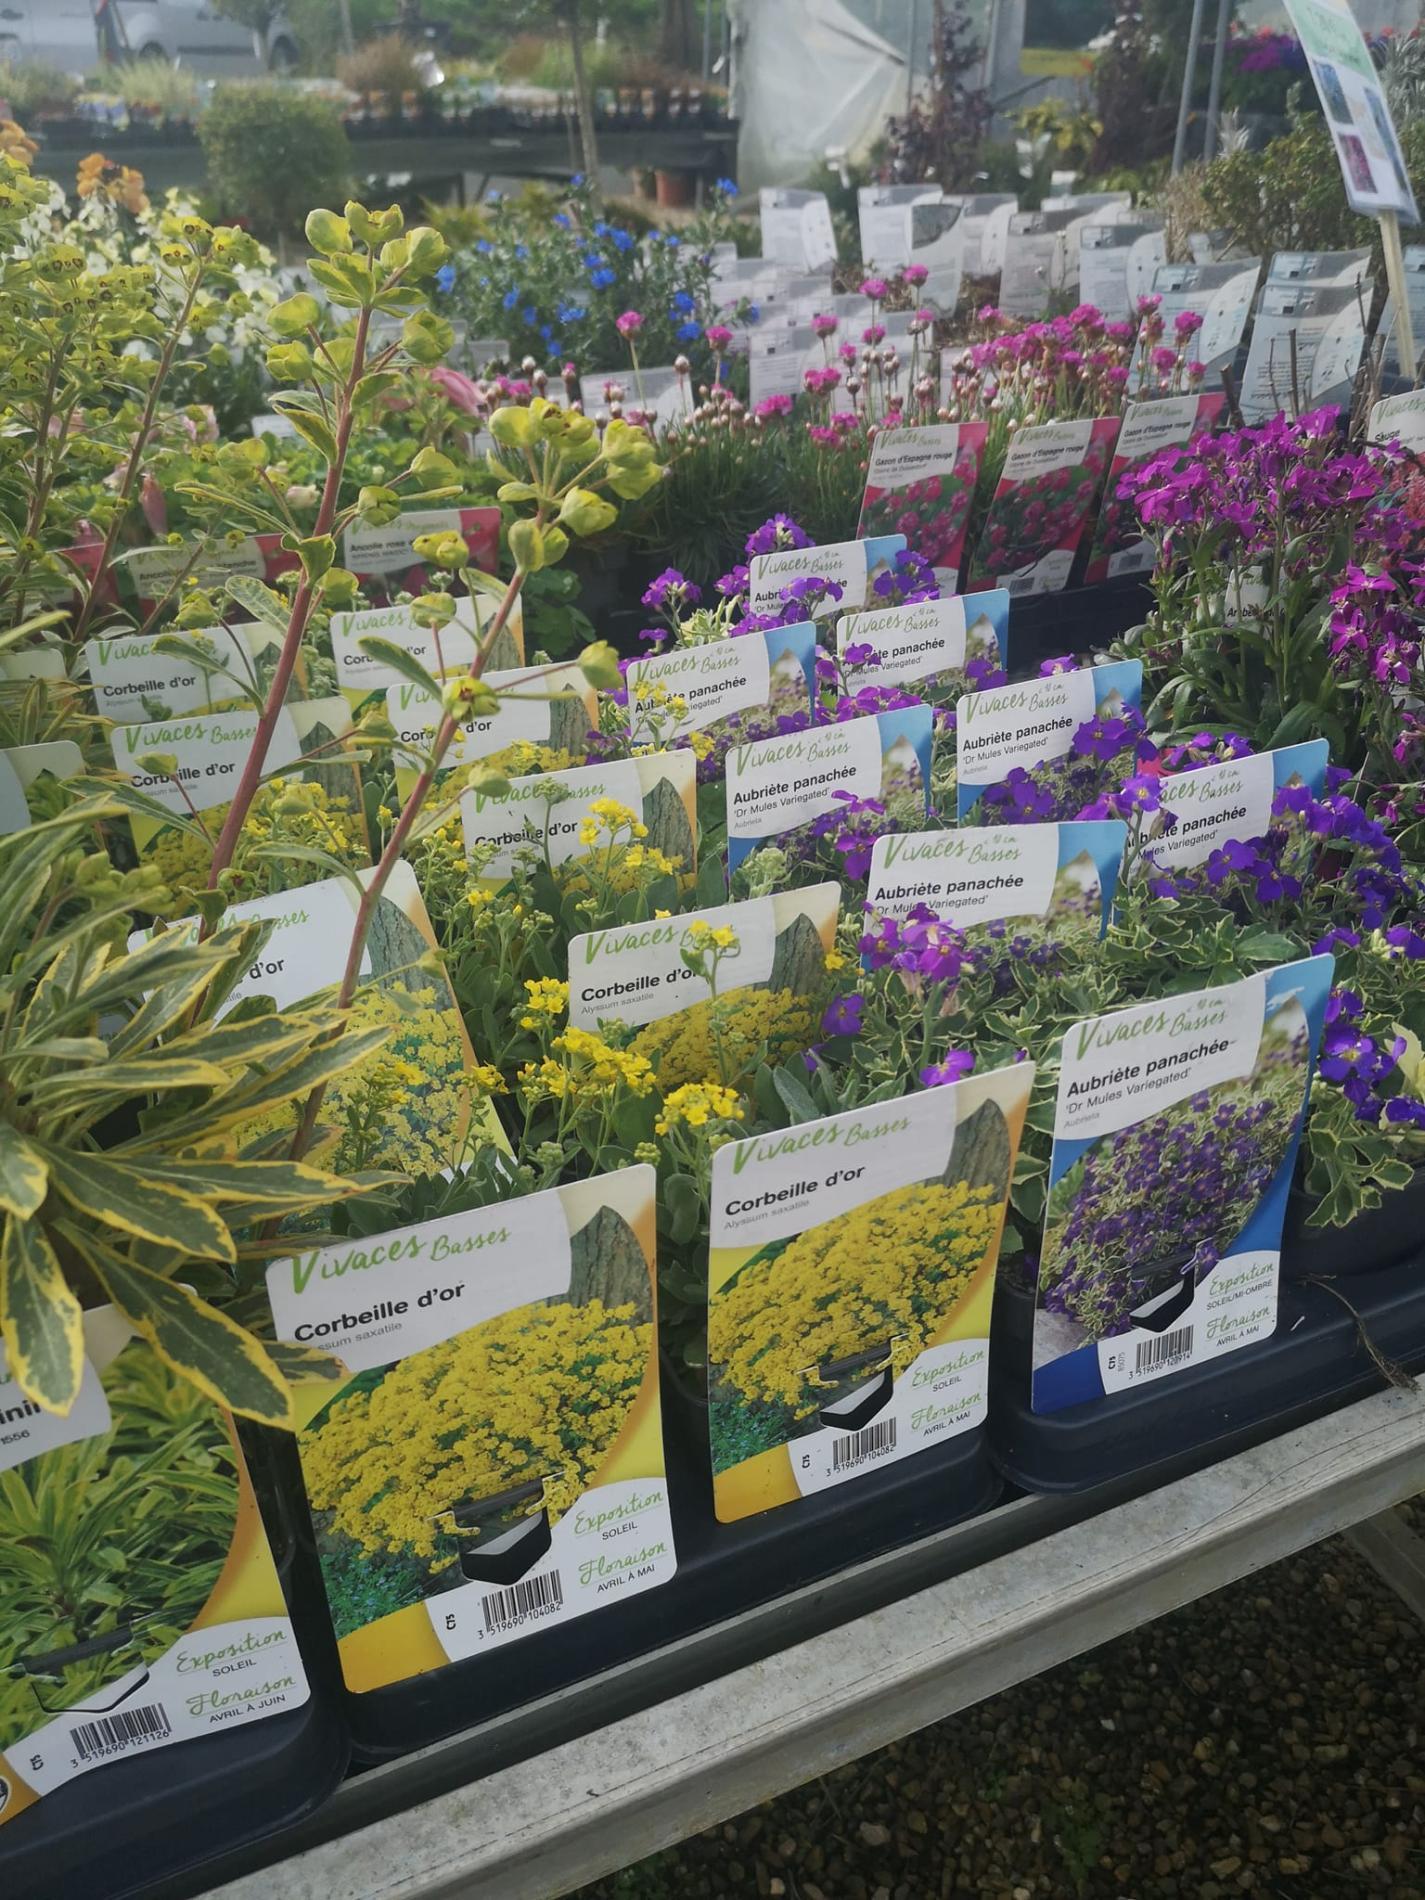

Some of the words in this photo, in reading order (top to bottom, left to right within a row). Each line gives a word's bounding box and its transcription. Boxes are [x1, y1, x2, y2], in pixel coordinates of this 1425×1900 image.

[758, 556, 809, 580] Vivaces
[845, 614, 902, 642] Vivaces
[903, 616, 940, 633] Basses
[892, 638, 945, 659] panachée
[637, 655, 697, 683] Vivaces
[700, 655, 741, 674] Basses
[103, 679, 166, 697] Corbeille
[169, 676, 196, 689] d'or
[689, 676, 747, 701] panachée
[966, 691, 1026, 724] Vivaces
[1028, 692, 1068, 712] Basses
[126, 722, 207, 753] Vivaces
[465, 721, 493, 734] d'or
[962, 731, 1012, 752] Aubriète
[1016, 716, 1073, 740] panachée
[205, 763, 236, 777] d'or
[736, 743, 805, 776] Vivaces
[807, 742, 850, 763] Basses
[977, 749, 1002, 761] Mules
[733, 783, 789, 805] Aubriète
[793, 765, 857, 790] panachée
[1198, 780, 1244, 802] Basses
[750, 800, 778, 814] Mules
[1182, 805, 1247, 835] panachée
[548, 822, 579, 837] d'or
[883, 836, 967, 870] Vivaces
[875, 882, 941, 901] Aubriète
[946, 874, 1024, 895] panachée
[584, 925, 678, 965] Vivaces
[249, 958, 285, 981] d'or
[580, 975, 660, 1002] Corbeille
[1076, 1011, 1167, 1061] Vivaces
[1168, 1010, 1226, 1038] Basses
[1067, 1066, 1141, 1098] Aubriète
[1145, 1039, 1229, 1076] panachée
[1086, 1090, 1123, 1108] Mules
[733, 1122, 843, 1175] Vivaces
[843, 1116, 912, 1148] Basses
[725, 1180, 818, 1216] Corbeille
[825, 1165, 867, 1188] d'or
[724, 1212, 769, 1230] Alyssum
[291, 1235, 426, 1294] Vivaces
[429, 1227, 512, 1261] Basses
[1208, 1261, 1274, 1296] Exposition
[294, 1300, 409, 1342] Corbeille
[417, 1284, 466, 1308] d'or
[1206, 1305, 1271, 1340] Floraison
[355, 1322, 403, 1341] saxatile
[1216, 1334, 1238, 1347] AVRIL
[1246, 1325, 1260, 1336] MAI
[911, 1349, 985, 1387] Exposition
[932, 1377, 962, 1393] SOLEIL
[911, 1391, 982, 1430] Floraison
[923, 1421, 947, 1436] AVRIL
[956, 1411, 971, 1423] MAI
[836, 1456, 865, 1474] 519690
[867, 1445, 895, 1462] 104082
[573, 1490, 664, 1536] Exposition
[602, 1520, 638, 1542] SOLEIL
[578, 1540, 667, 1586] Floraison
[597, 1577, 625, 1594] AVRIL
[637, 1564, 656, 1578] MAI
[478, 1629, 484, 1640] 3
[489, 1615, 525, 1636] 519690
[528, 1601, 562, 1622] 104082
[176, 1628, 288, 1673] Exposition
[212, 1657, 257, 1678] SOLEIL
[186, 1675, 297, 1716] Floraison
[209, 1708, 243, 1724] AVRIL
[258, 1693, 287, 1709] JUIN
[70, 1757, 79, 1769] 3
[86, 1741, 125, 1762] 519690
[130, 1729, 169, 1747] 121126
